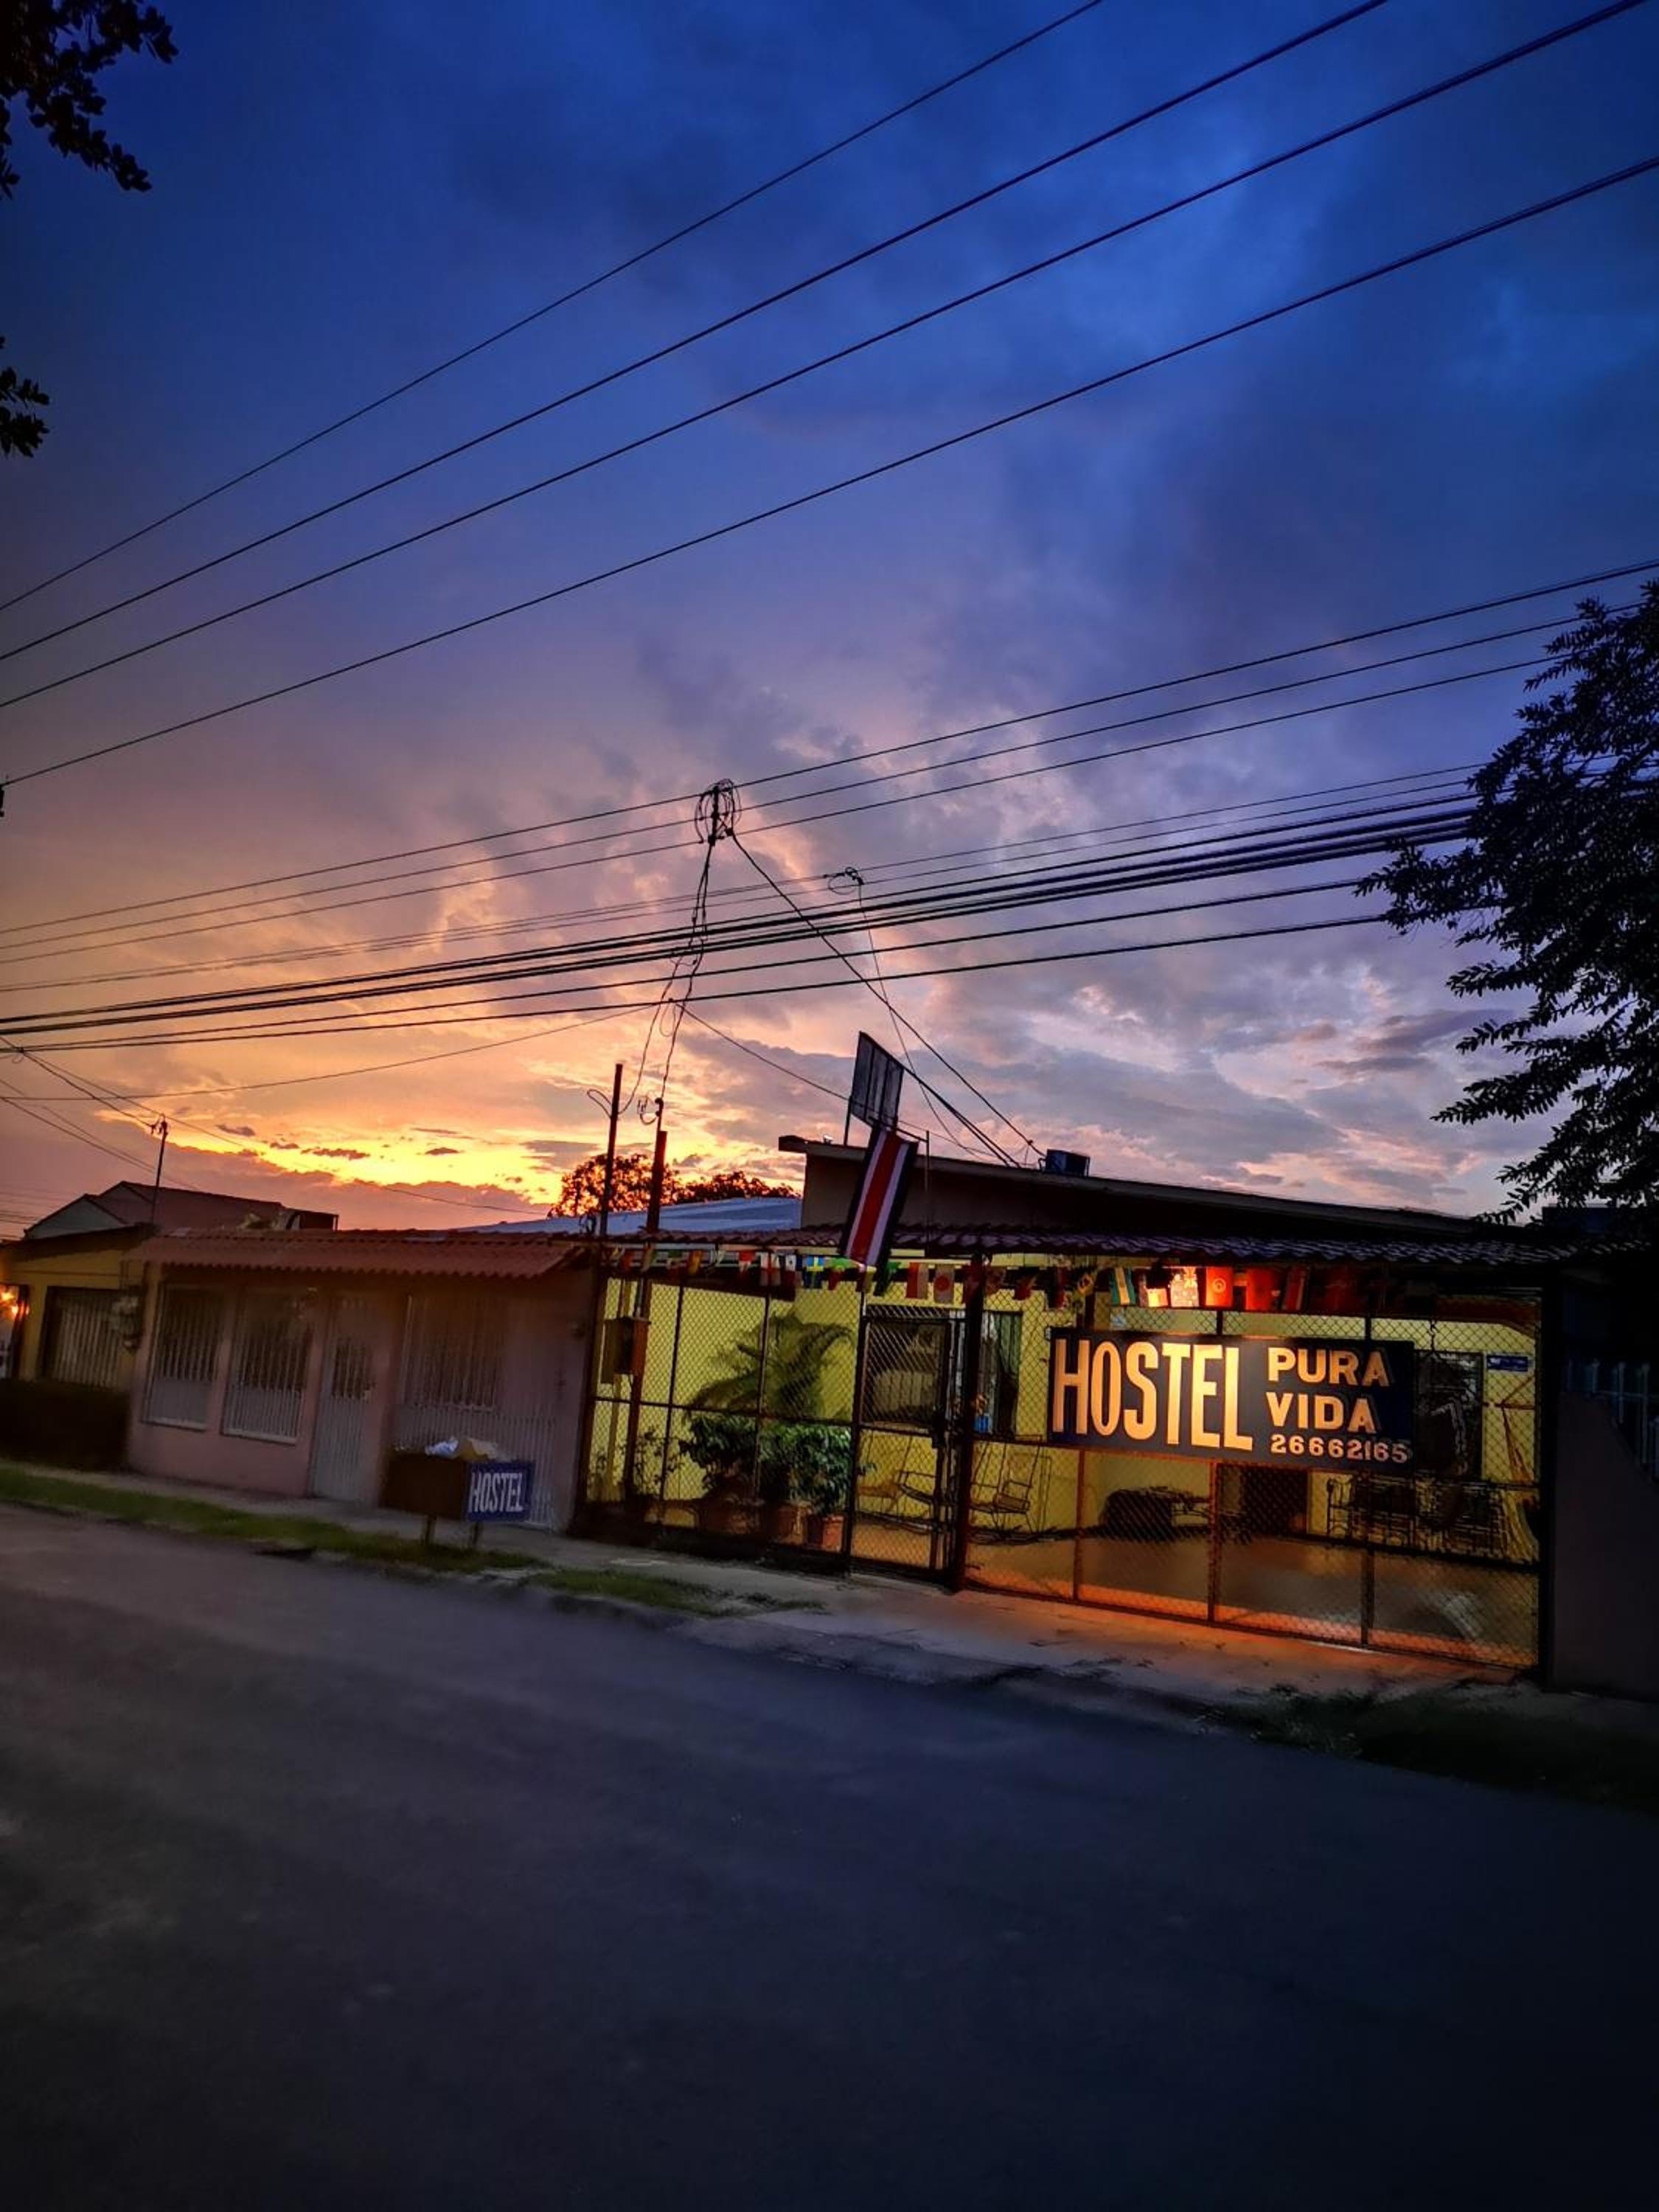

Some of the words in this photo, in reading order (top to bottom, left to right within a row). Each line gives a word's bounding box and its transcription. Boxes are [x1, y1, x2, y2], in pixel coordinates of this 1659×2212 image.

[1267, 1346, 1391, 1388] PURA
[1051, 1338, 1253, 1452] HOSTEL
[1265, 1391, 1378, 1435] VIDA
[1270, 1433, 1409, 1464] 26662165
[468, 1471, 524, 1513] HOSTEL
